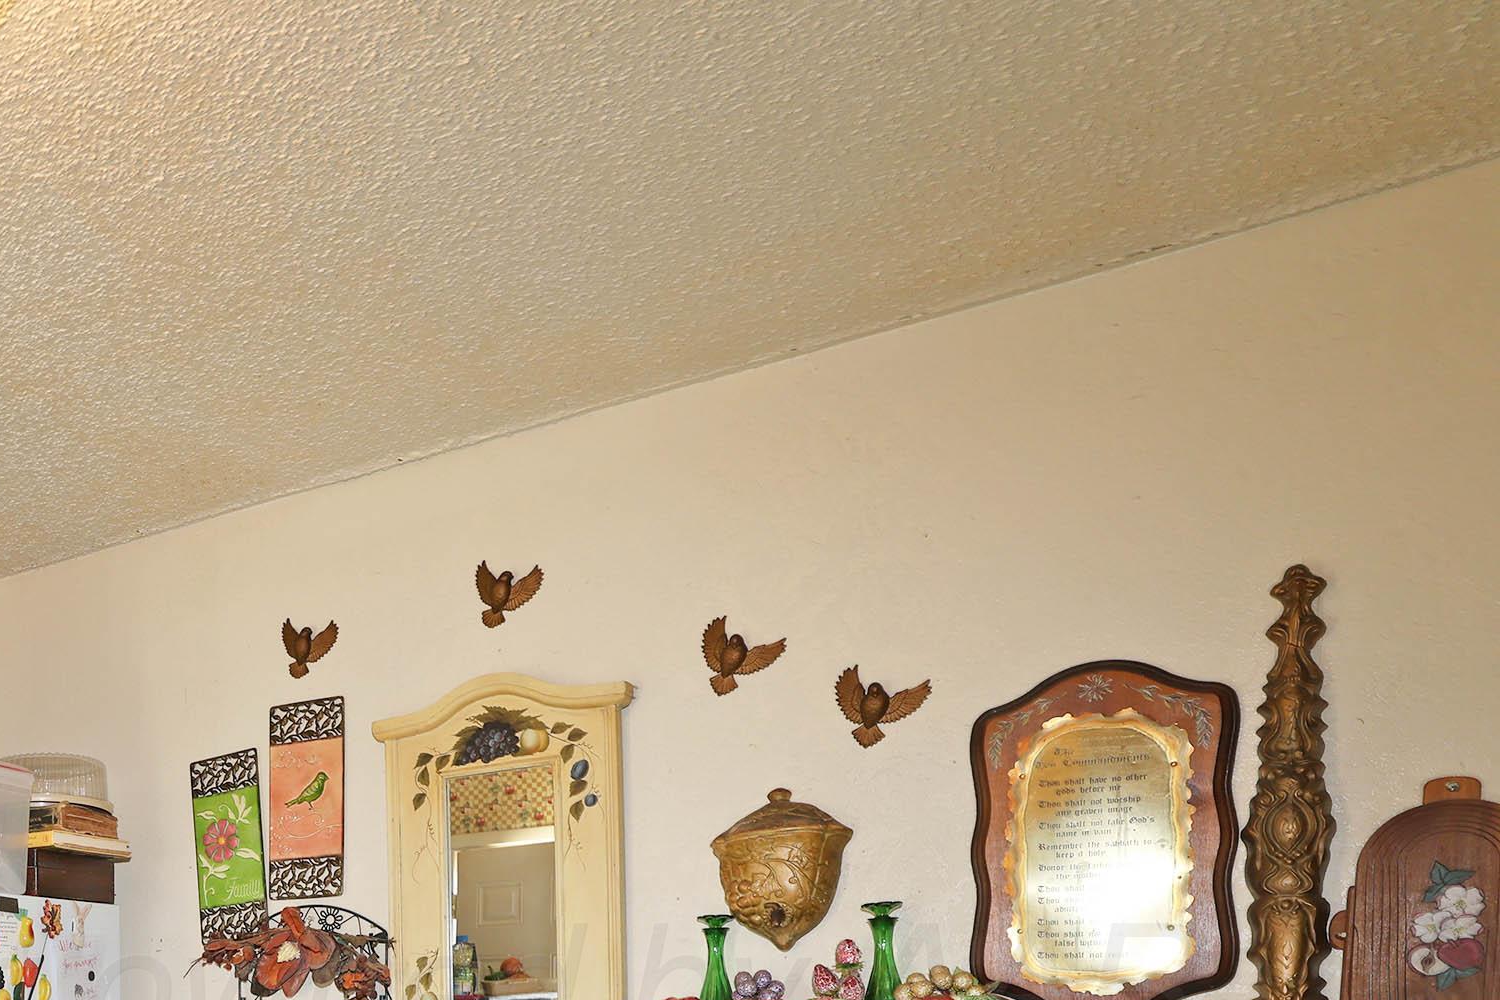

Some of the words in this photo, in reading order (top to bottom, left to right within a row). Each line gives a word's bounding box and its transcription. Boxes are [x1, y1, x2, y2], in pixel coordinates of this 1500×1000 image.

[1089, 776, 1107, 784] have
[1080, 786, 1105, 794] before
[1039, 800, 1061, 808] Thou
[1107, 796, 1141, 804] worship
[1075, 808, 1103, 816] graven
[1107, 806, 1133, 814] image
[1129, 816, 1155, 824] God's
[1039, 842, 1082, 850] Remember
[227, 877, 261, 899] Family
